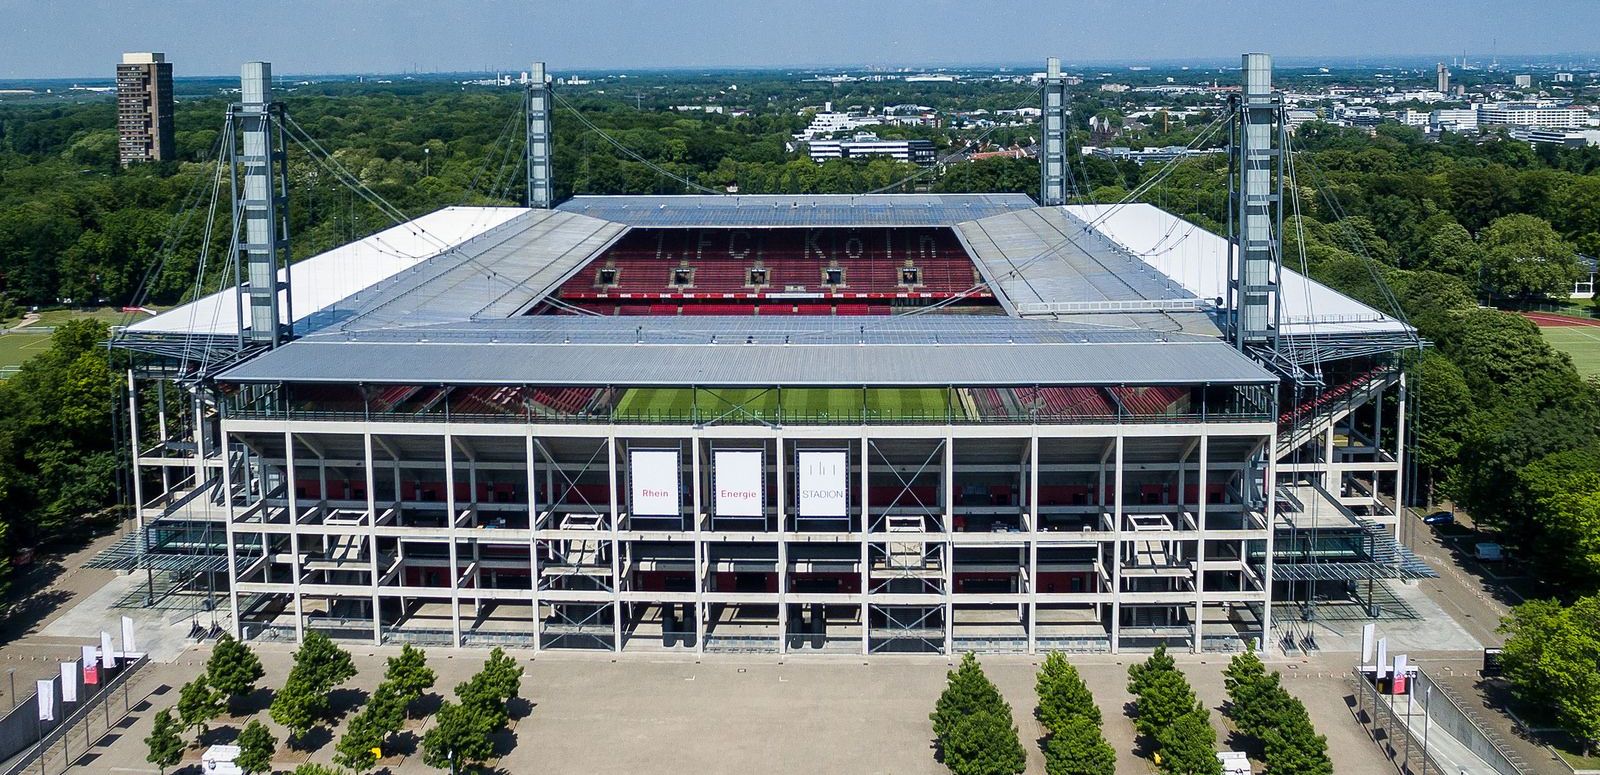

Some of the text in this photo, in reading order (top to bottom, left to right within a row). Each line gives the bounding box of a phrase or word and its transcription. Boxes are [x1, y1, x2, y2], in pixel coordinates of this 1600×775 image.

[696, 230, 751, 259] FC
[804, 228, 937, 259] Köln
[642, 489, 669, 498] Rhein
[721, 490, 757, 500] Energie
[802, 490, 844, 499] STADION
